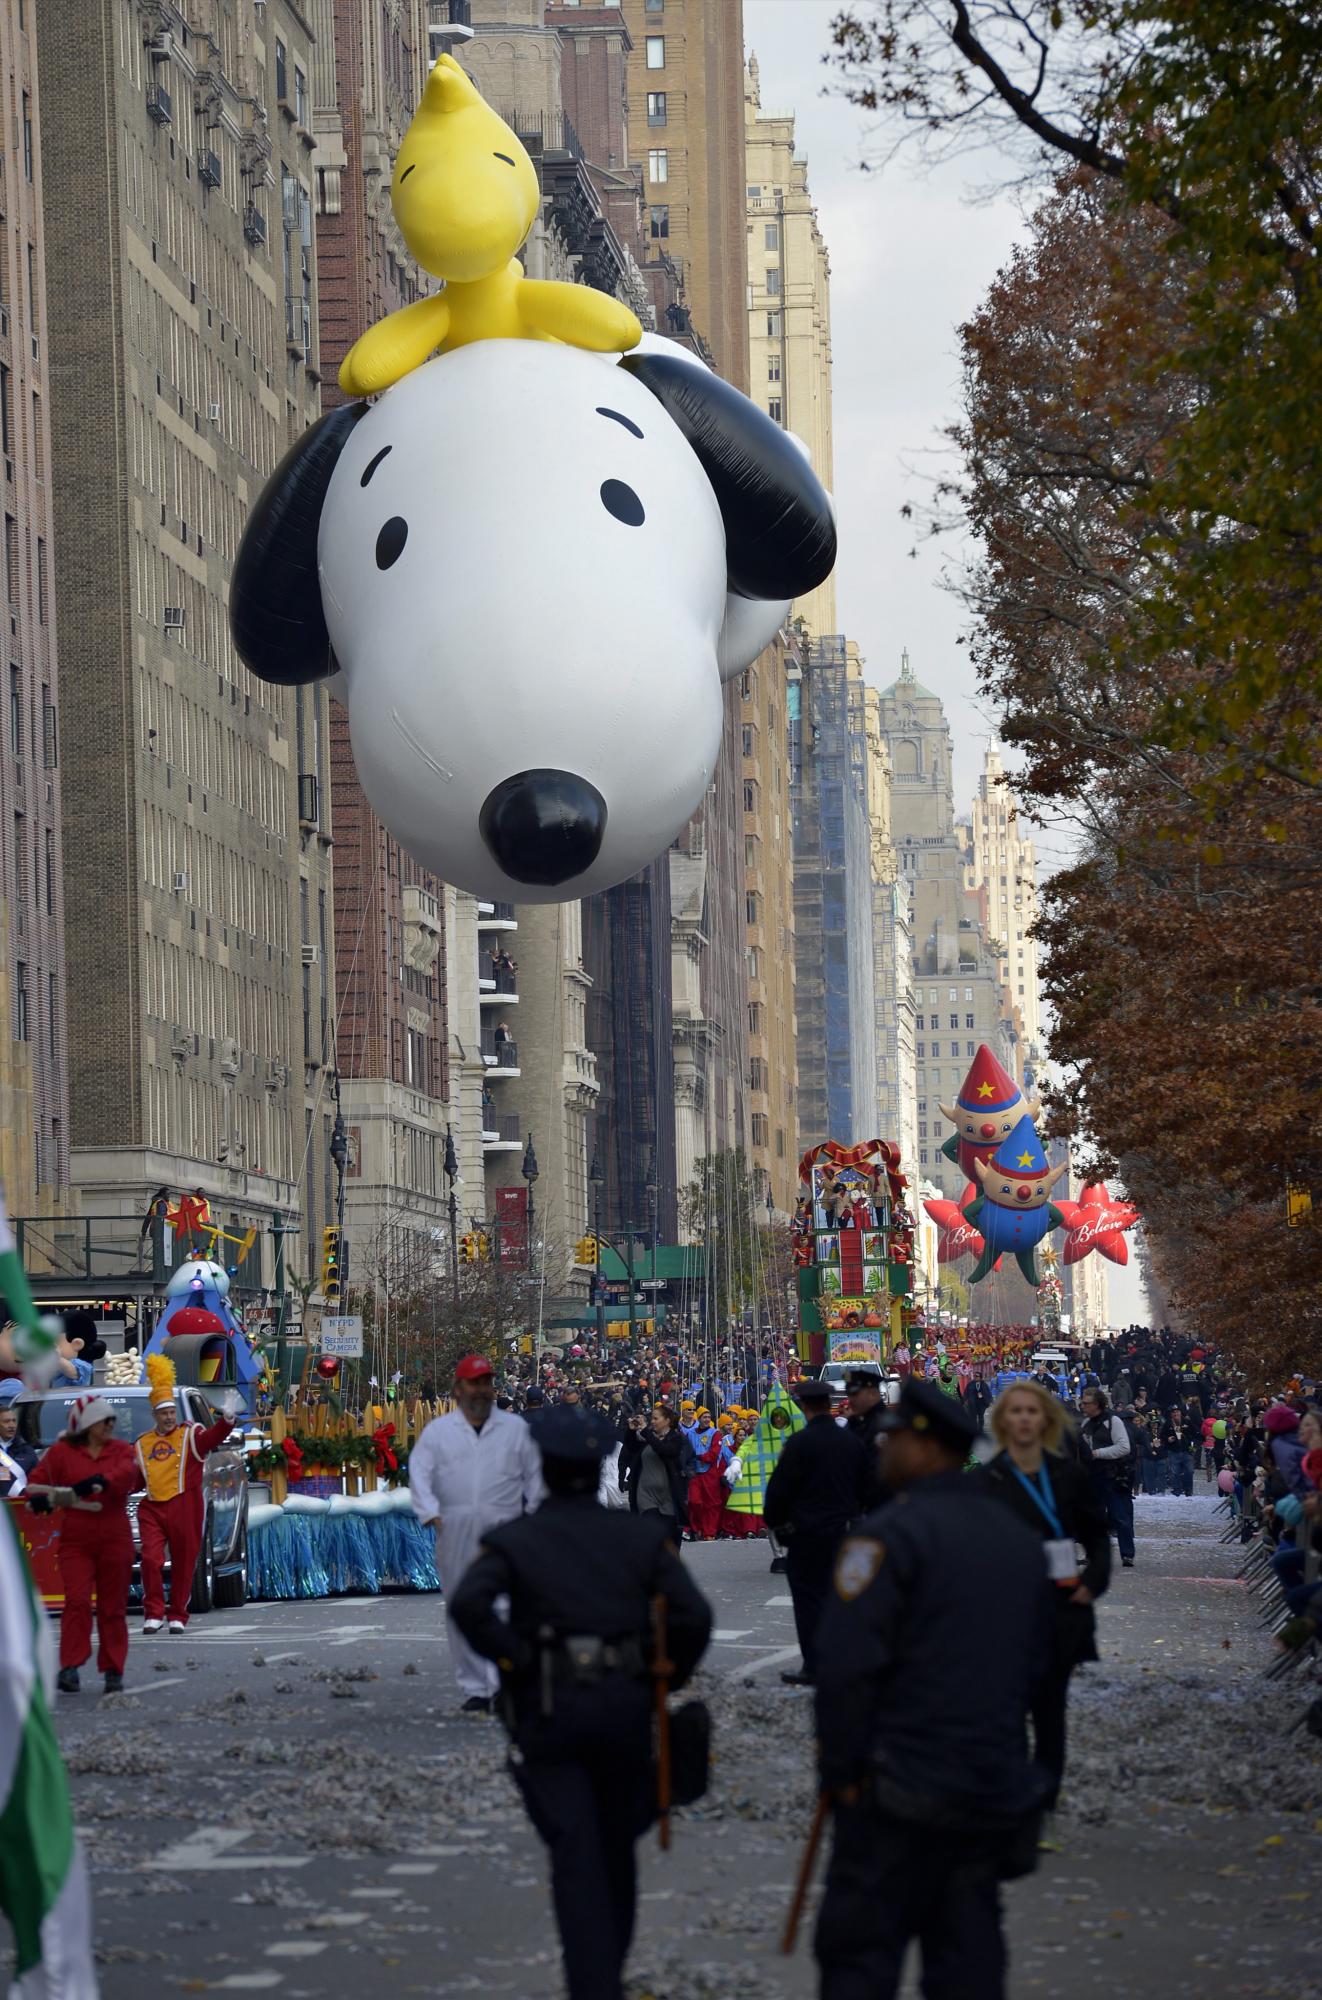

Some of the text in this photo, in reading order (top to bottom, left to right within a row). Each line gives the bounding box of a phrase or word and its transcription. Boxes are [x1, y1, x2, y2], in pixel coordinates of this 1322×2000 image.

[946, 1223, 981, 1244] Beli
[1070, 1212, 1122, 1245] Believe
[329, 1319, 354, 1327] NYPD
